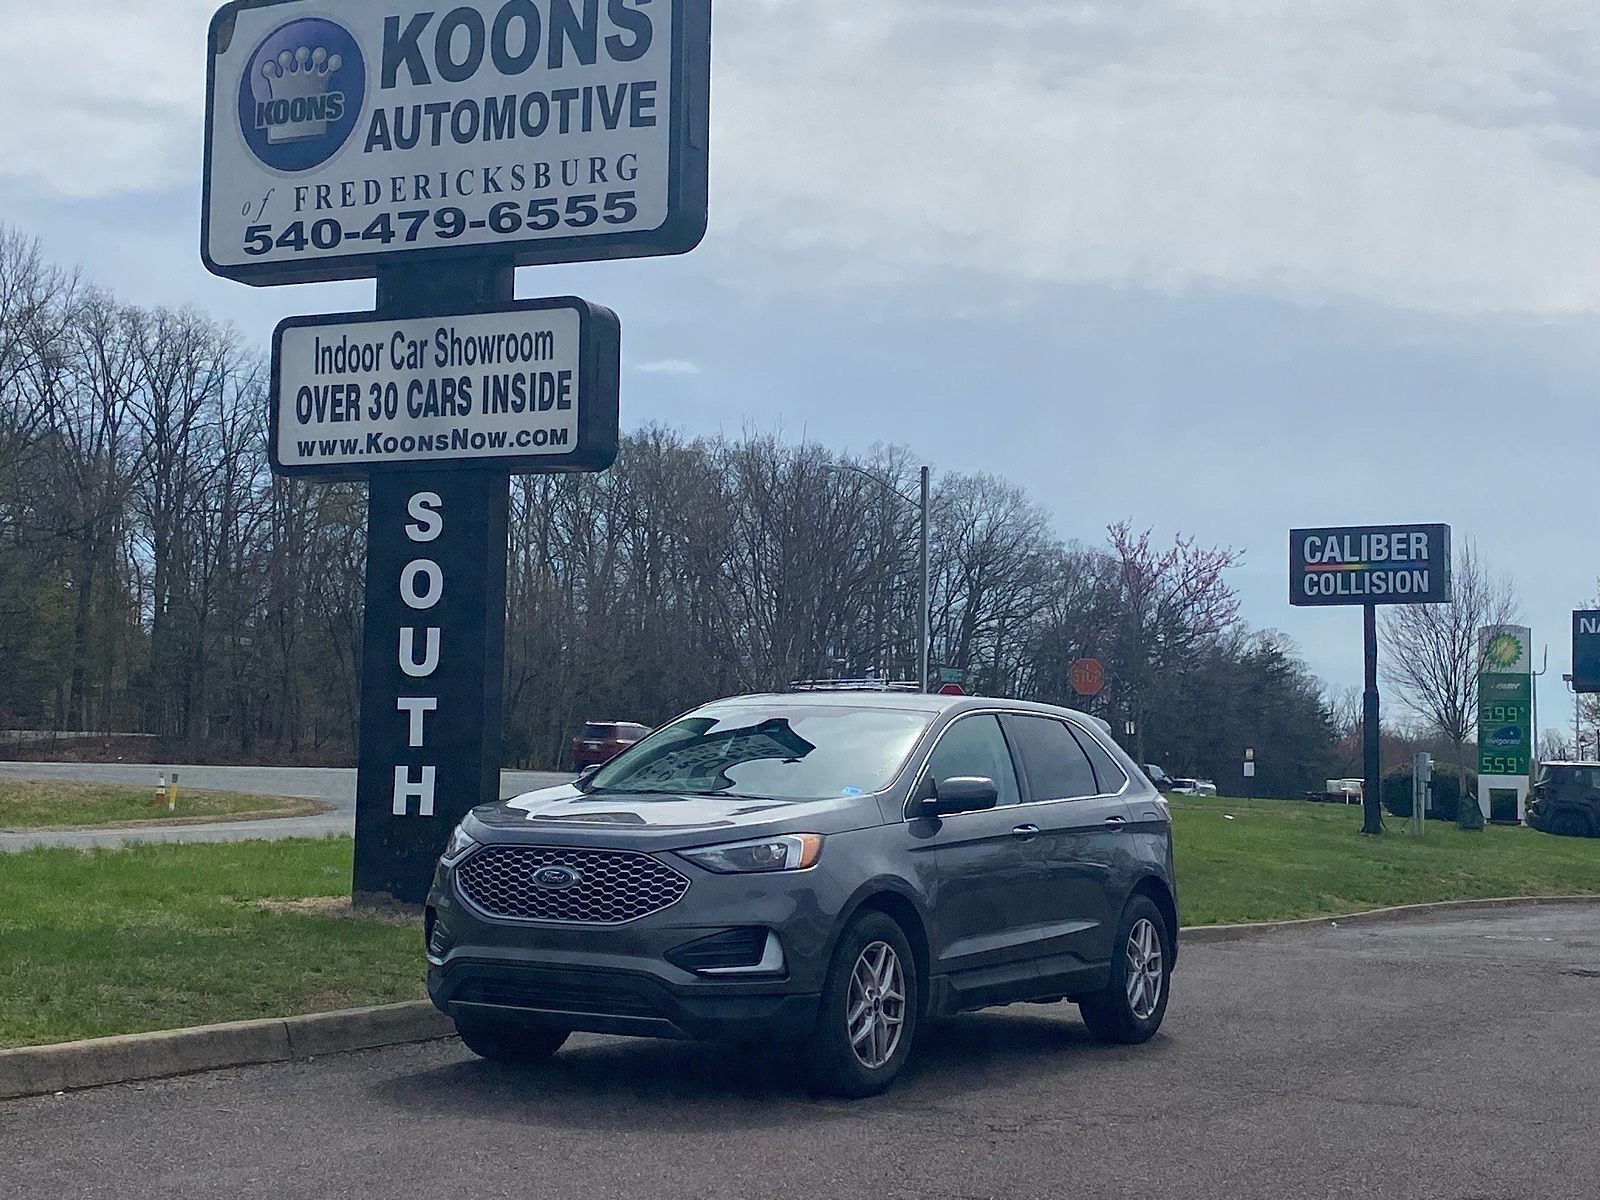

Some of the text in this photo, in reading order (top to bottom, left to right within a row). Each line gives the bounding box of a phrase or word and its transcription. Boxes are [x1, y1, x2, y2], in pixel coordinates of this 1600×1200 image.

[381, 0, 653, 89] KOONS
[255, 93, 345, 129] KOONS
[364, 81, 657, 153] AUTOMOTIVE
[241, 153, 639, 222] of FREDERICKSBURG
[243, 191, 637, 256] 540-479-6555
[315, 327, 554, 375] Indoor Car Showroom
[296, 370, 572, 425] OVER 30 CARS INSIDE
[1304, 532, 1429, 563] CALIBER
[1304, 570, 1429, 596] COLLISION
[393, 491, 444, 816] SOUTH
